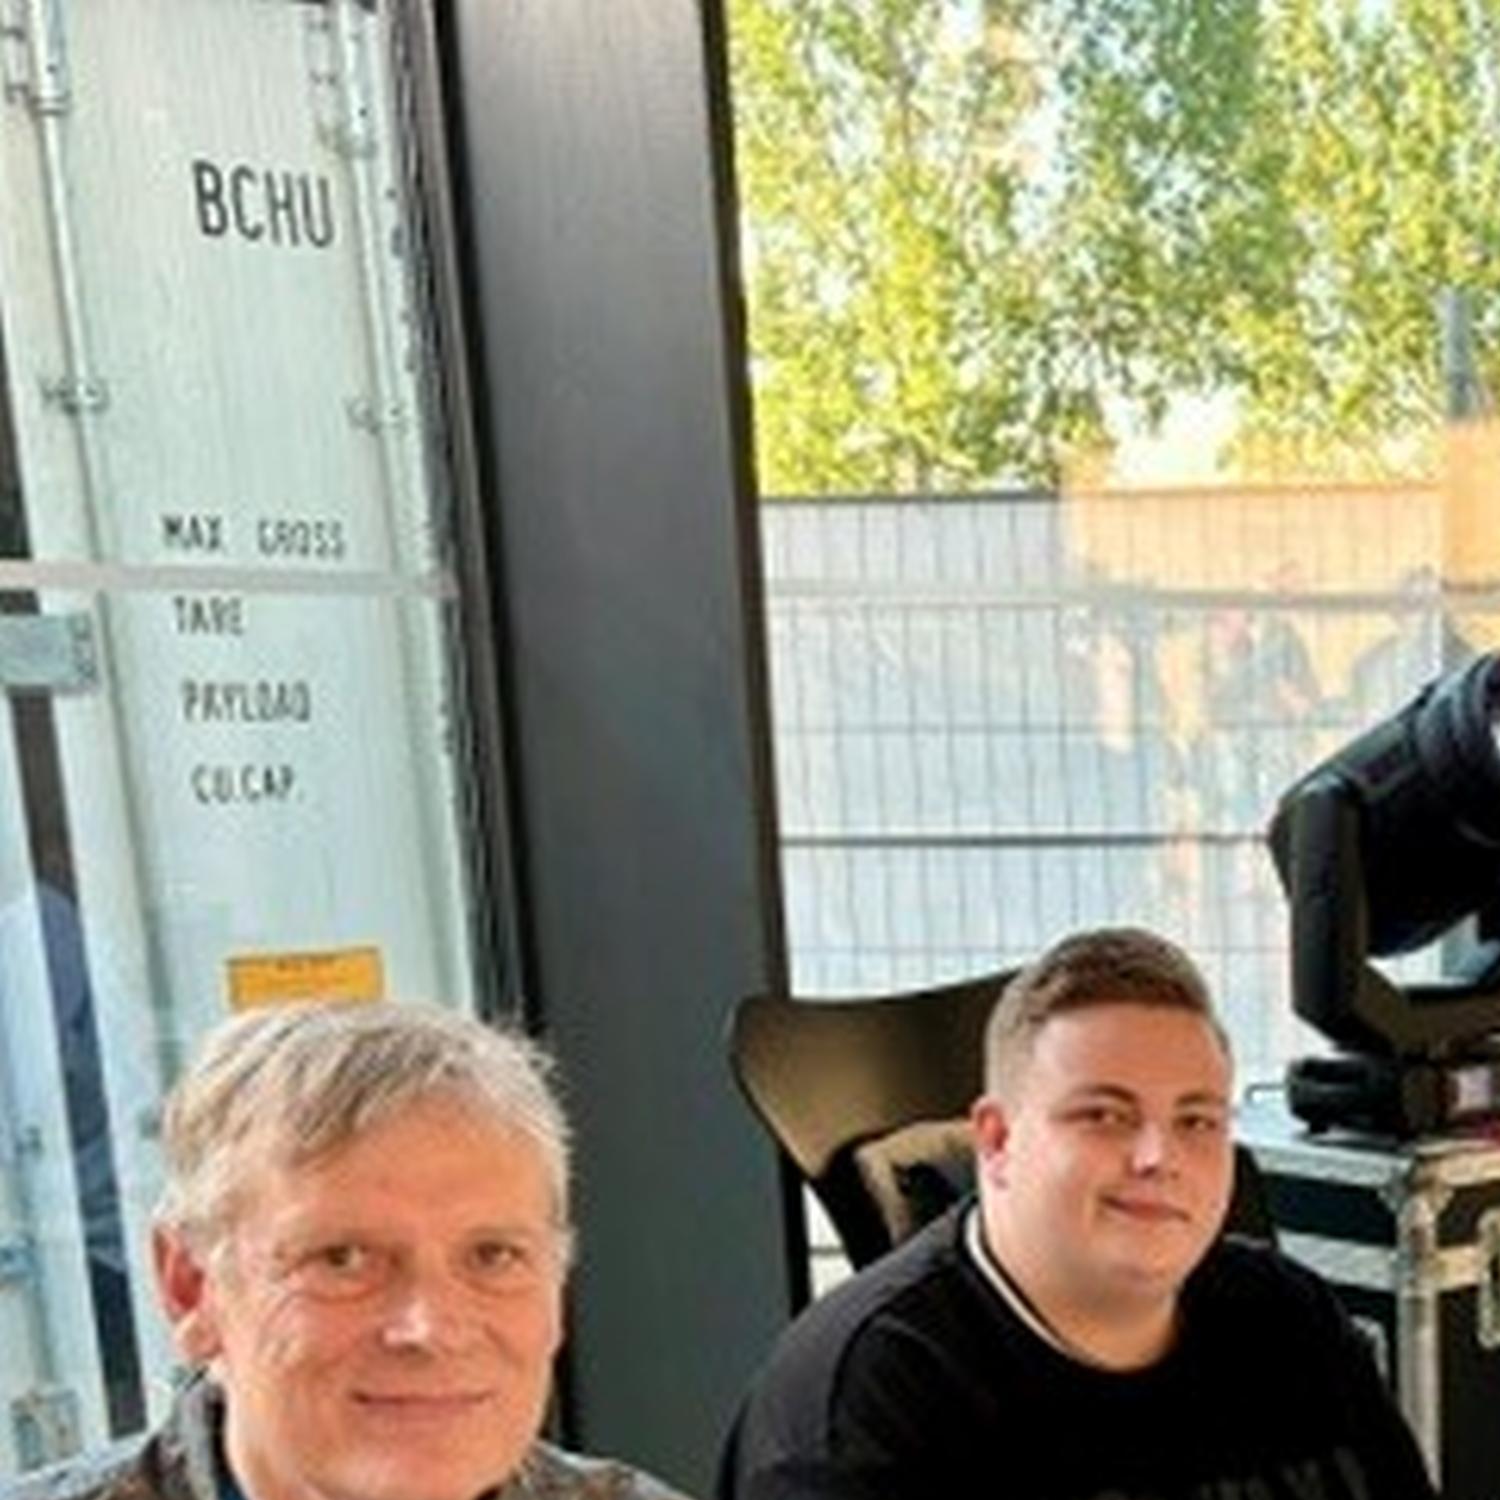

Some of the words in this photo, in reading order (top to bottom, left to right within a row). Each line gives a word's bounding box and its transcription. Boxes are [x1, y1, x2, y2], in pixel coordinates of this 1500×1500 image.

[193, 160, 335, 248] BCHU
[162, 515, 221, 551] MAX
[258, 519, 344, 558] GROSS
[173, 595, 244, 636] TARE
[182, 680, 310, 722] PAYLOAD
